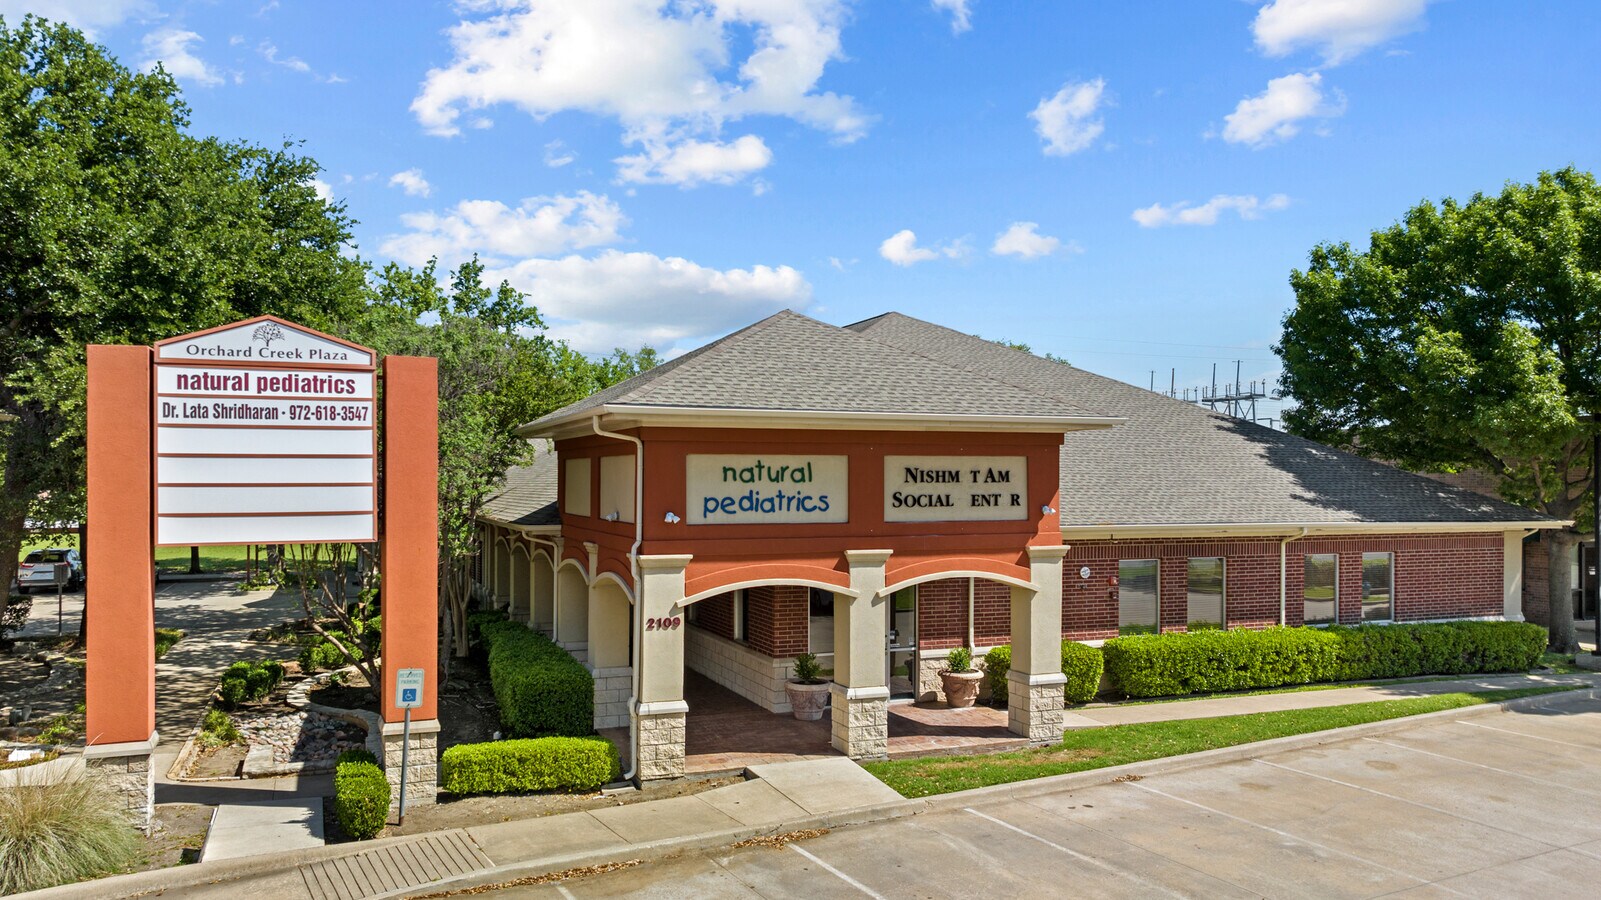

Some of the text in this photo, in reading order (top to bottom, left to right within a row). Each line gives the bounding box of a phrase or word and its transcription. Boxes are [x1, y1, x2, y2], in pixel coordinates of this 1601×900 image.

[186, 344, 348, 361] Orchard Creek Plaza
[176, 371, 356, 395] natural pediatrics
[162, 401, 369, 422] Dr. Lata Shridharan 972-618-3547
[722, 460, 813, 483] natural
[703, 489, 830, 519] pediatrics
[892, 491, 954, 508] SOCIAL
